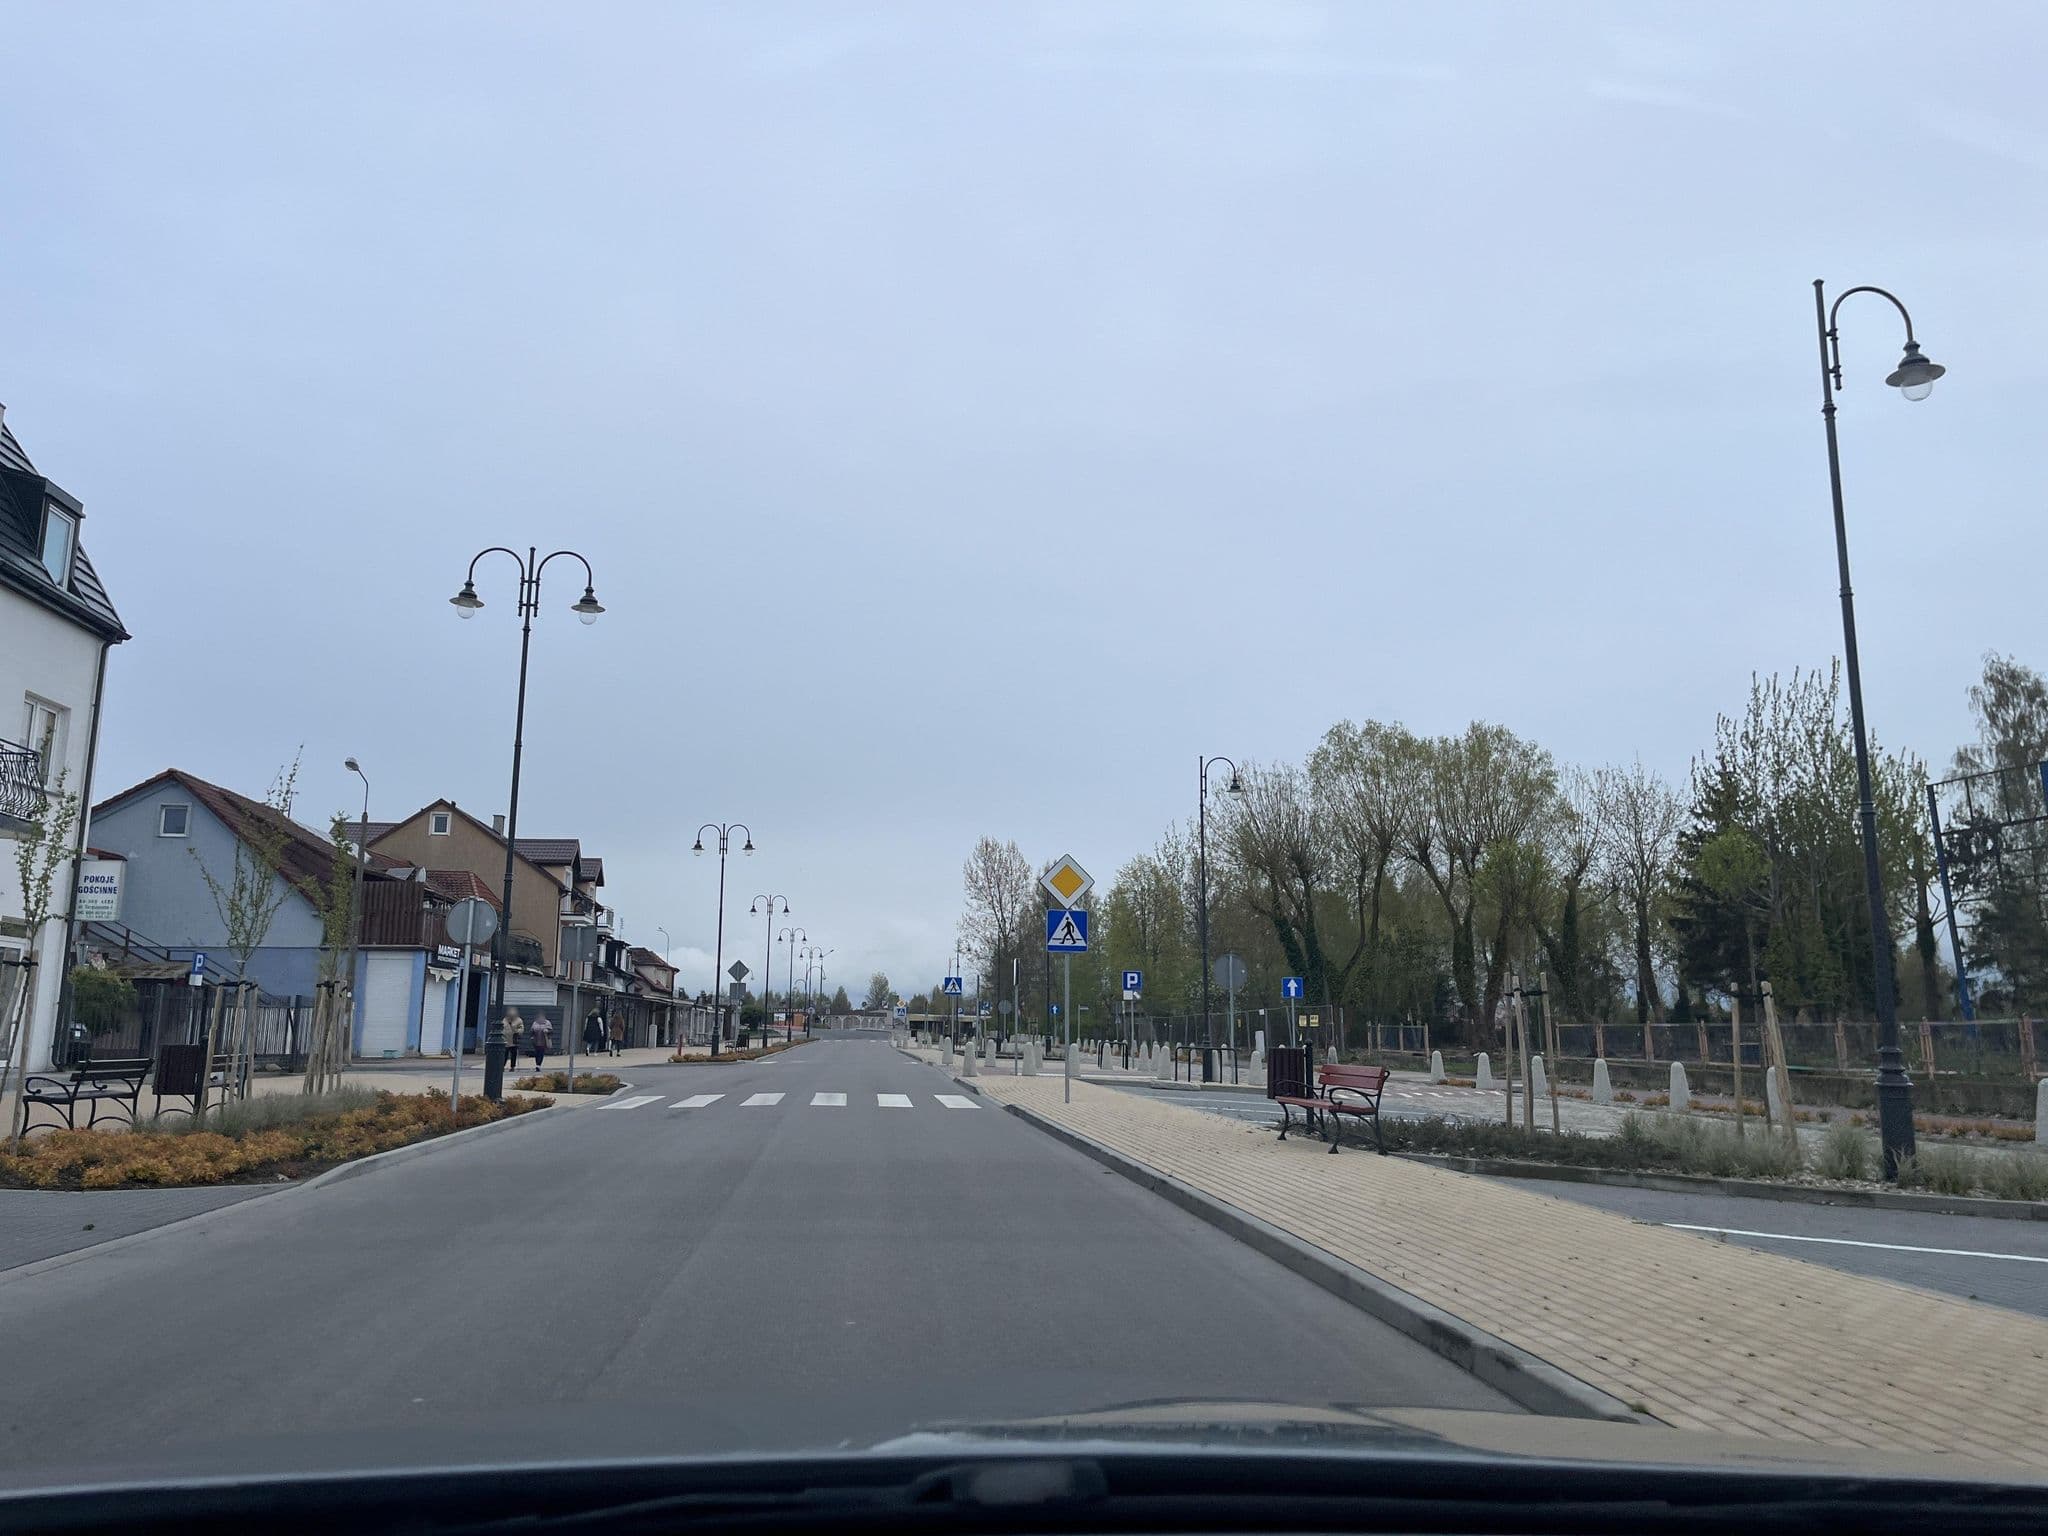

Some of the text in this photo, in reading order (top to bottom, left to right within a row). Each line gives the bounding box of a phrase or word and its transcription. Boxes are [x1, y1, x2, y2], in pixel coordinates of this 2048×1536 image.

[84, 875, 115, 884] POKOJE
[438, 944, 461, 958] MARKET
[195, 954, 204, 972] P
[1127, 973, 1138, 989] P
